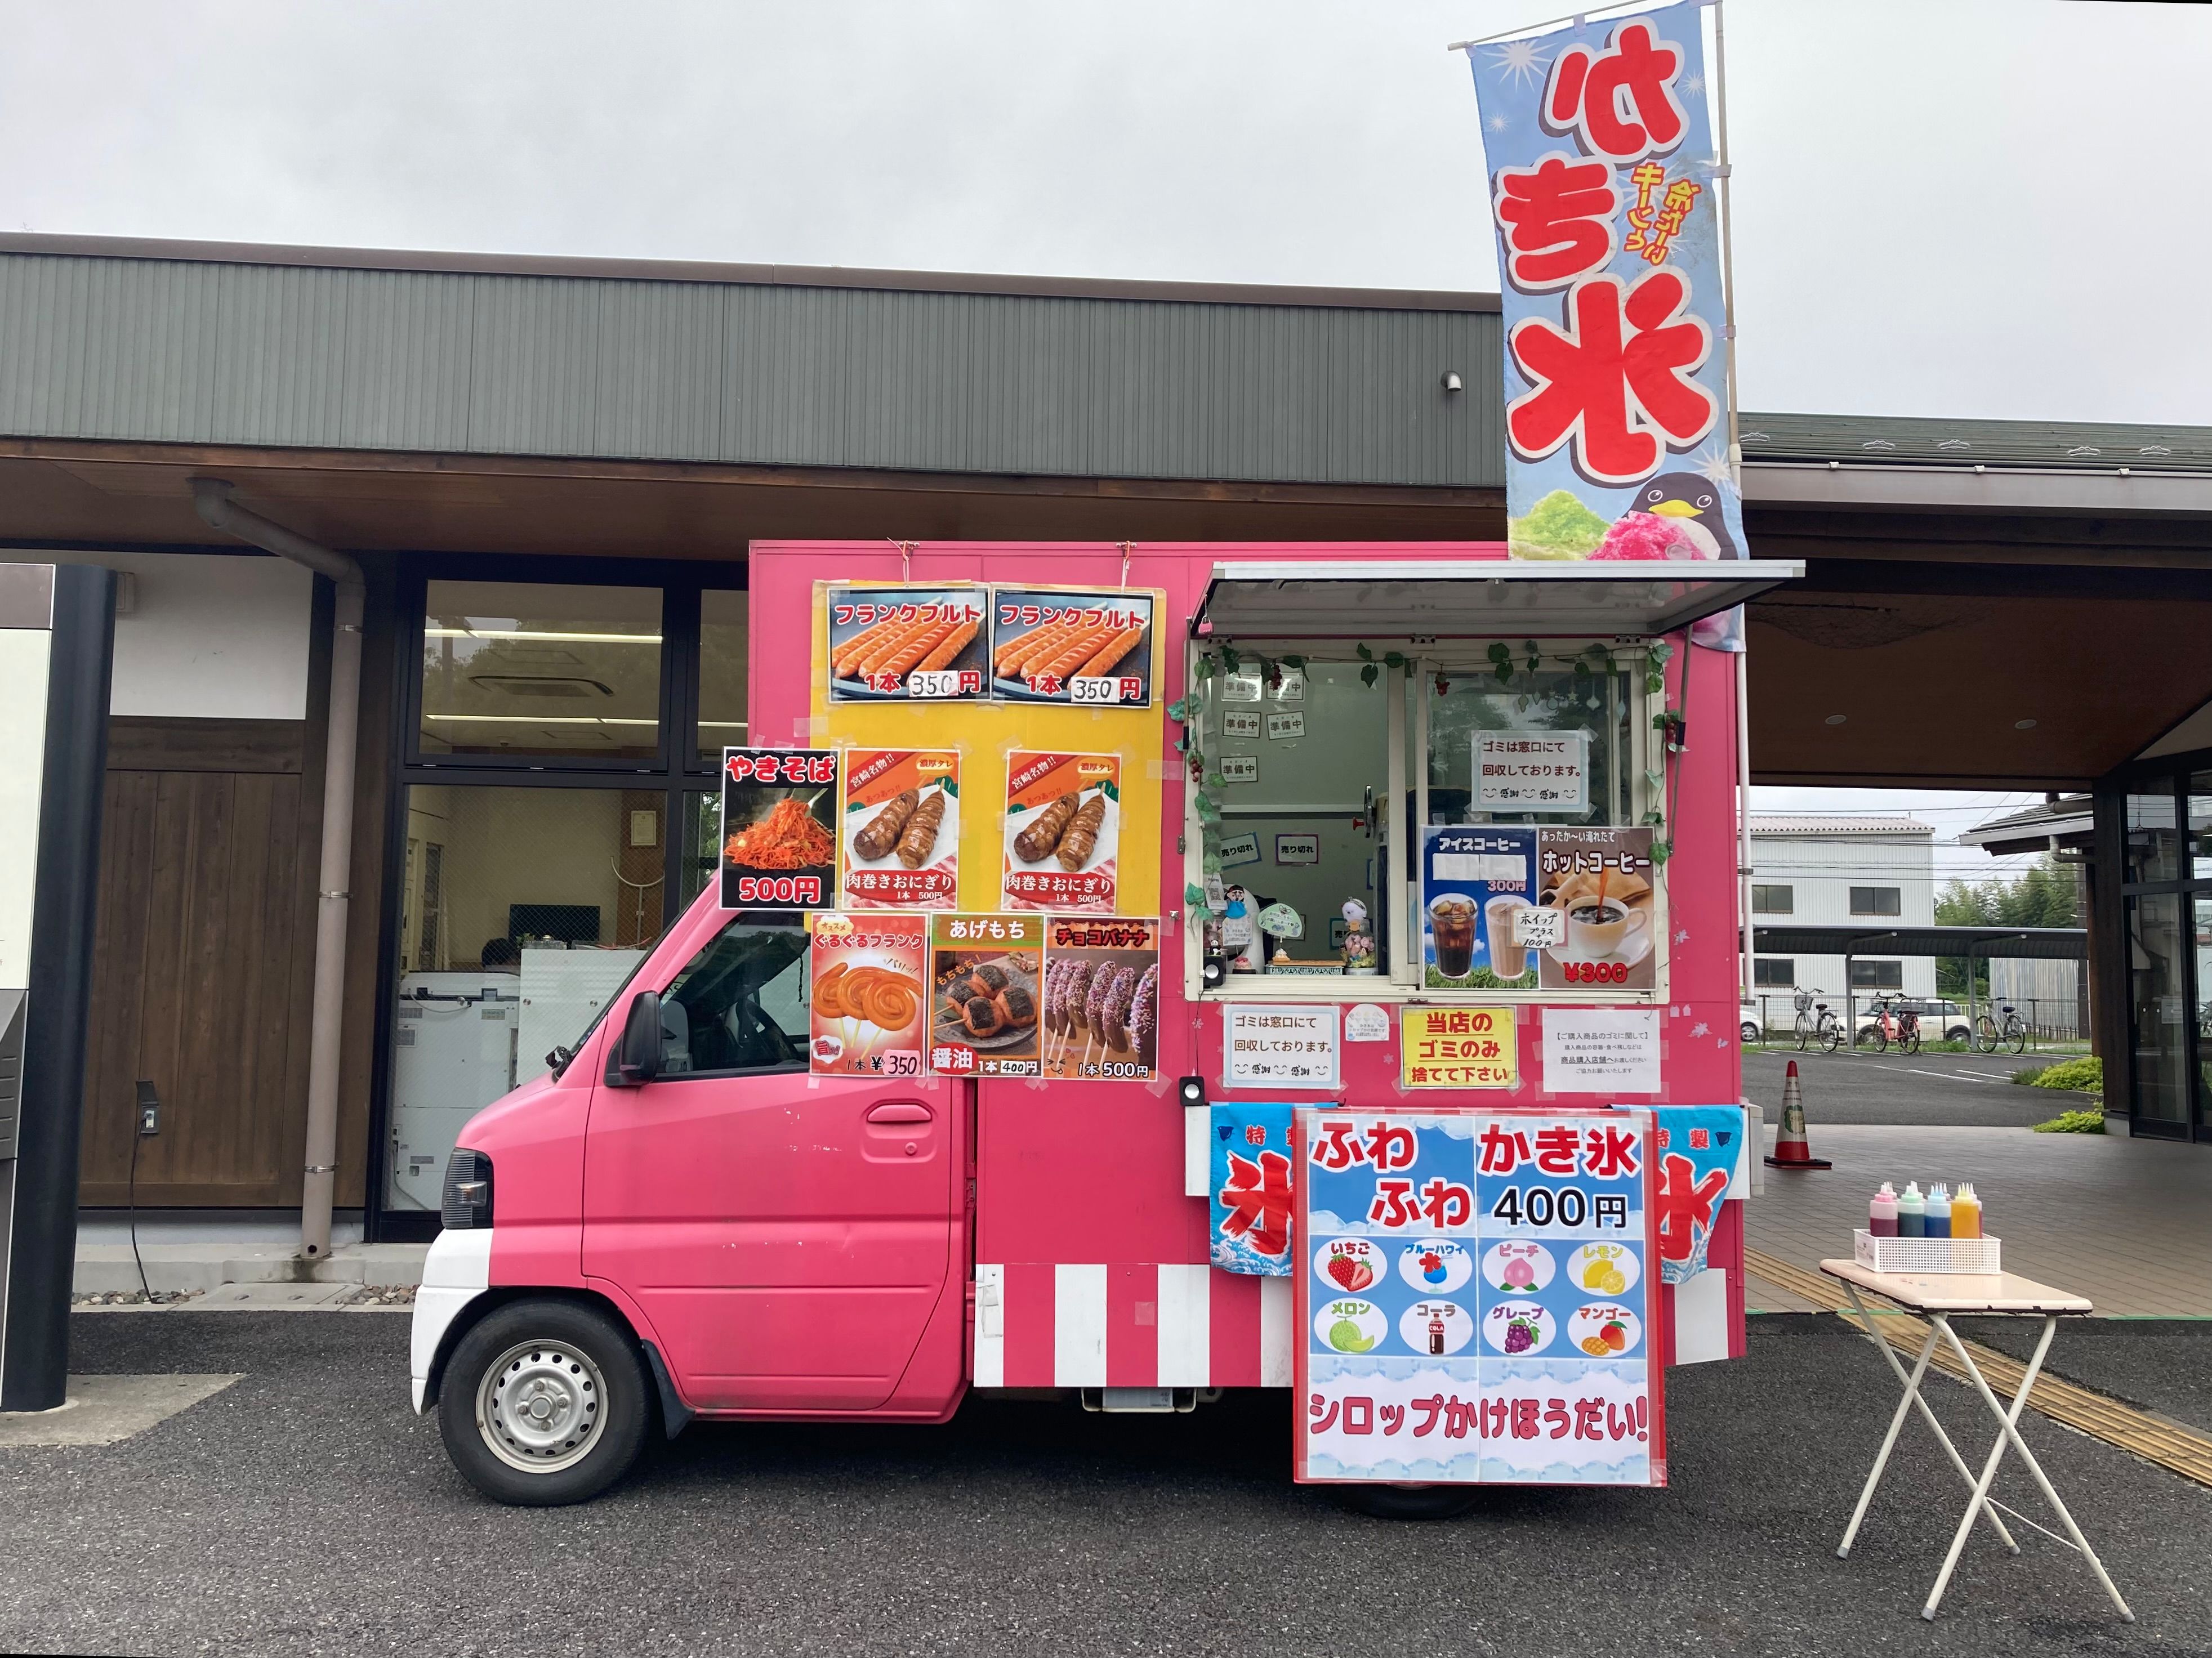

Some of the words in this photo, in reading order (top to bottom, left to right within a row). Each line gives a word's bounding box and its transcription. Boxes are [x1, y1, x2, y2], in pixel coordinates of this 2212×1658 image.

[835, 604, 983, 625] フランクフルト
[1000, 604, 1145, 630] フランクフルト
[1483, 741, 1565, 753] ゴミは窓口にて
[725, 754, 835, 783] やきそば
[920, 759, 953, 768] 濃厚タレ
[1081, 762, 1113, 771] 濃厚タレ
[1482, 764, 1581, 777] 回収しております。
[1221, 843, 1255, 857] 売り切れ
[1281, 845, 1315, 854] 売り切れ
[1438, 837, 1521, 852] アイスコーヒー
[1542, 849, 1651, 874] ホットコーヒー
[846, 872, 953, 891] 肉巻きおにぎり
[1006, 873, 1112, 895] 肉巻きおにぎり
[1487, 880, 1526, 893] 300円
[738, 876, 820, 903] 500円
[918, 891, 943, 901] 500円
[1077, 894, 1101, 905] 500円
[1520, 913, 1558, 924] ホイップ
[821, 922, 846, 931] オススメ
[949, 920, 1025, 940] あげもち
[814, 933, 924, 949] ぐるぐるフランク
[1056, 928, 1150, 948] チョコバナナ
[1523, 939, 1551, 948] 100円
[1563, 962, 1629, 984] ¥300
[1235, 1016, 1317, 1029] ゴミは窓口にて
[1426, 1012, 1493, 1033] 当店の
[1234, 1039, 1332, 1053] 回収しております。
[1419, 1039, 1501, 1058] ゴミのみ
[1411, 1066, 1508, 1082] 捨てて下さい
[1312, 1121, 1418, 1173] ふわ
[1478, 1124, 1640, 1180] かき氷
[1371, 1175, 1475, 1230] ふわ
[1493, 1187, 1627, 1228] 400円
[1331, 1242, 1370, 1255] いちご
[1406, 1243, 1464, 1255] ブルーハワイ
[1499, 1245, 1539, 1258] ピーチ
[1584, 1246, 1623, 1258] レモン
[1331, 1302, 1370, 1315] メロン
[1417, 1304, 1456, 1317] コーラ
[1492, 1306, 1544, 1320] グレープ
[1578, 1307, 1631, 1320] マンゴー
[1309, 1394, 1648, 1442] シロップかけほうだい!
